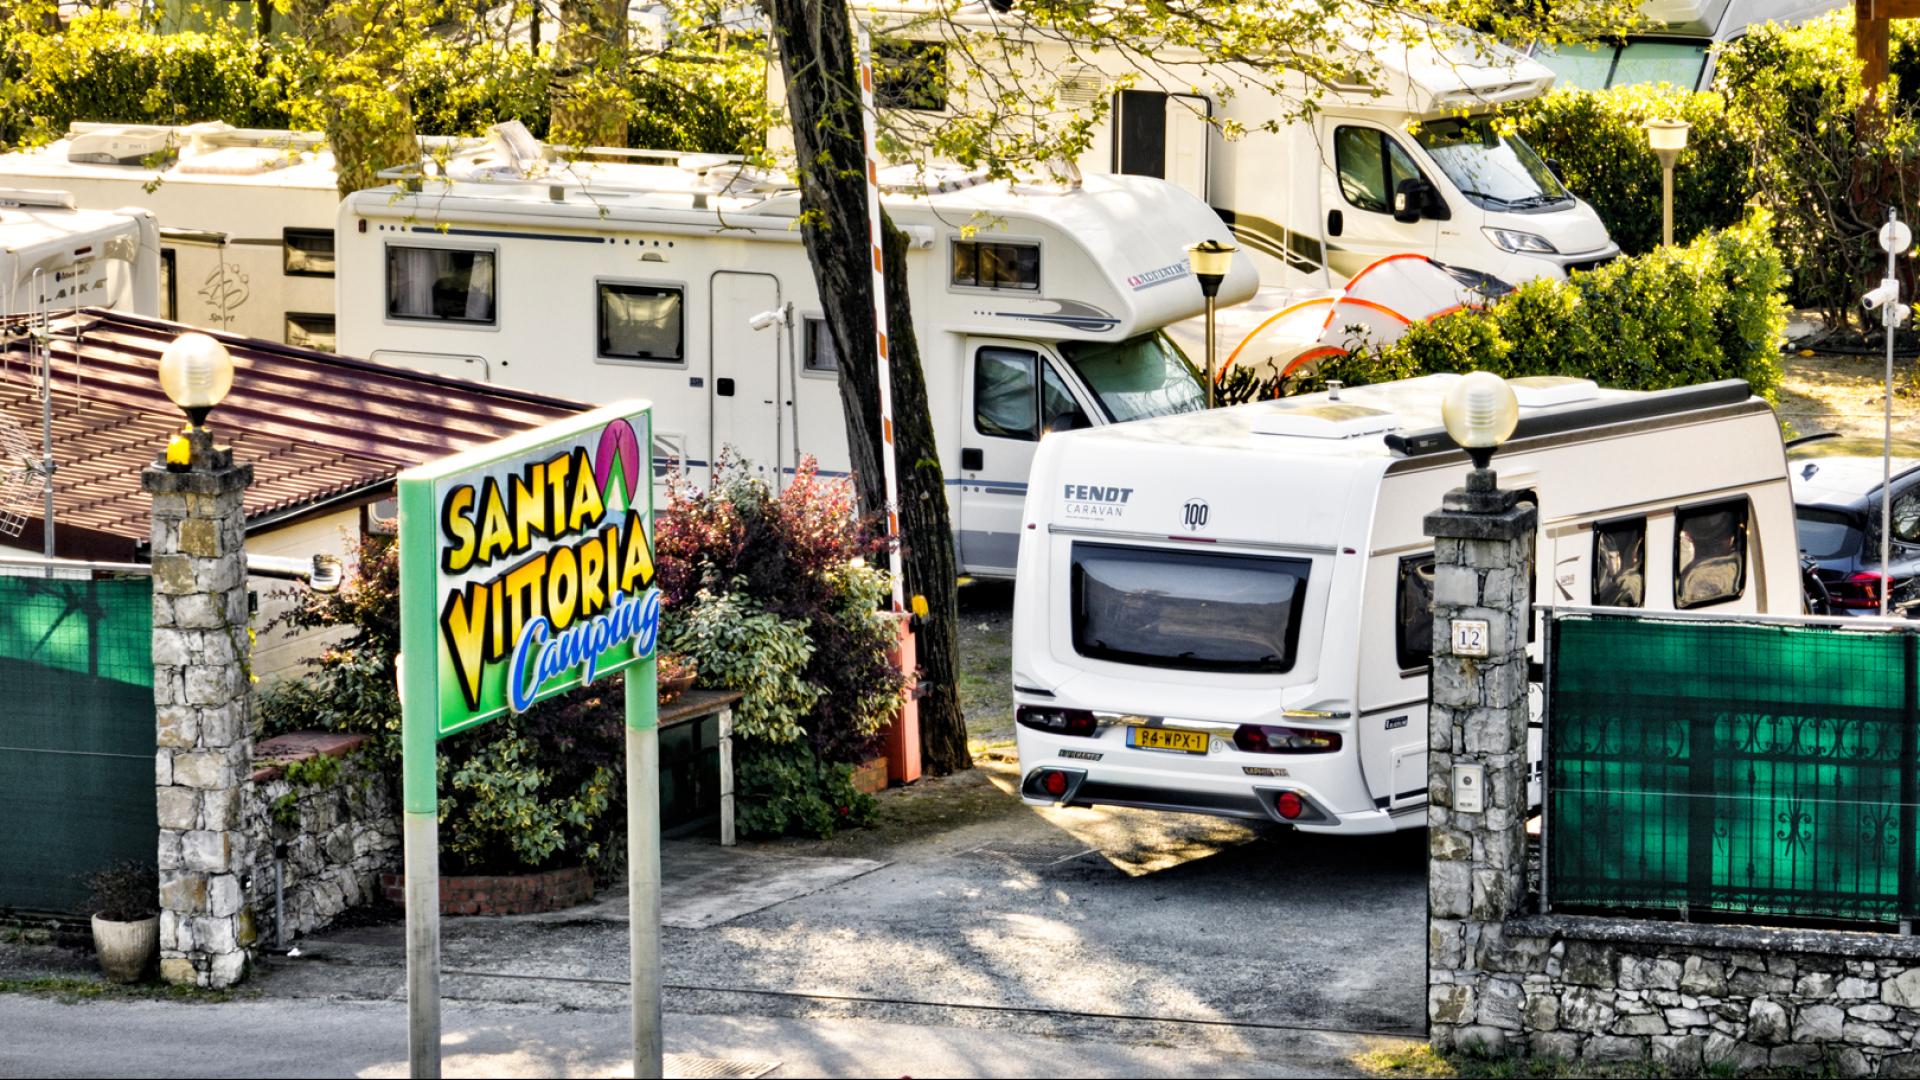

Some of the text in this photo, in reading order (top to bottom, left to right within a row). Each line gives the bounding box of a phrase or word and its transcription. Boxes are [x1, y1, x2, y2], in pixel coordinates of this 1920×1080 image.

[1064, 484, 1134, 503] FENDT
[441, 446, 607, 575] SANTA
[1066, 503, 1123, 517] CARAVAN
[1184, 503, 1208, 526] 100
[440, 509, 656, 712] VITTORIA
[1460, 630, 1480, 646] 12
[507, 588, 661, 713] Camping
